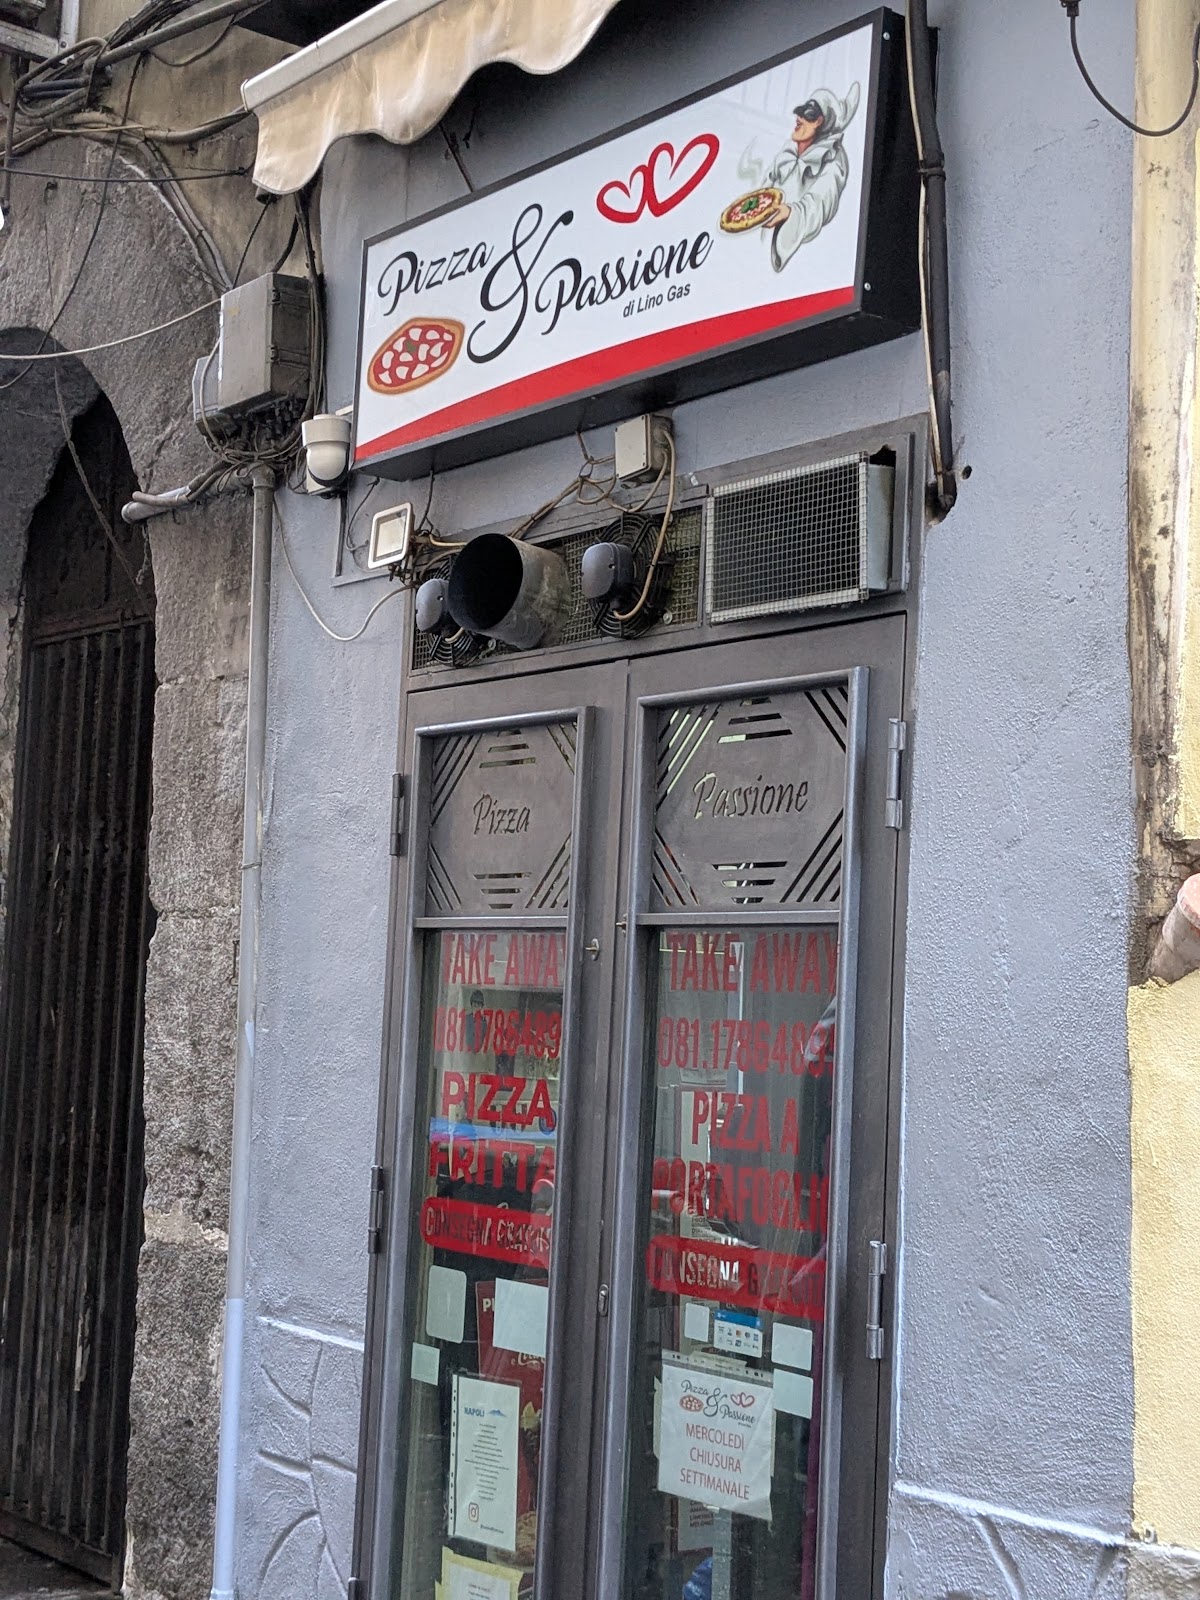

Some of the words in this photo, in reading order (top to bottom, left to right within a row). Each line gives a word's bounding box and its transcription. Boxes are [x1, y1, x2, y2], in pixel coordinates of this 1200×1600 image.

[378, 241, 494, 316] Pizza
[467, 203, 574, 364] &
[535, 231, 714, 335] Passione
[622, 299, 634, 318] di
[637, 291, 664, 315] Lino
[667, 282, 691, 303] Gas
[473, 793, 530, 836] Pizza
[693, 771, 809, 820] Passione
[443, 933, 498, 986] TAKE
[504, 932, 567, 987] AWA
[667, 931, 741, 992] TAKE
[442, 1070, 557, 1133] PIZZA
[691, 1090, 771, 1153] PIZZA
[780, 1097, 800, 1155] A
[652, 1246, 741, 1291] CONSEGNA
[463, 1407, 485, 1418] NAPOLI
[681, 1379, 709, 1393] Pizza
[703, 1387, 728, 1418] &
[720, 1404, 756, 1424] Passione
[685, 1423, 744, 1450] MERCOLEDÌ
[689, 1446, 742, 1474] CHIUSURA
[680, 1467, 750, 1500] SETTIMANALE
